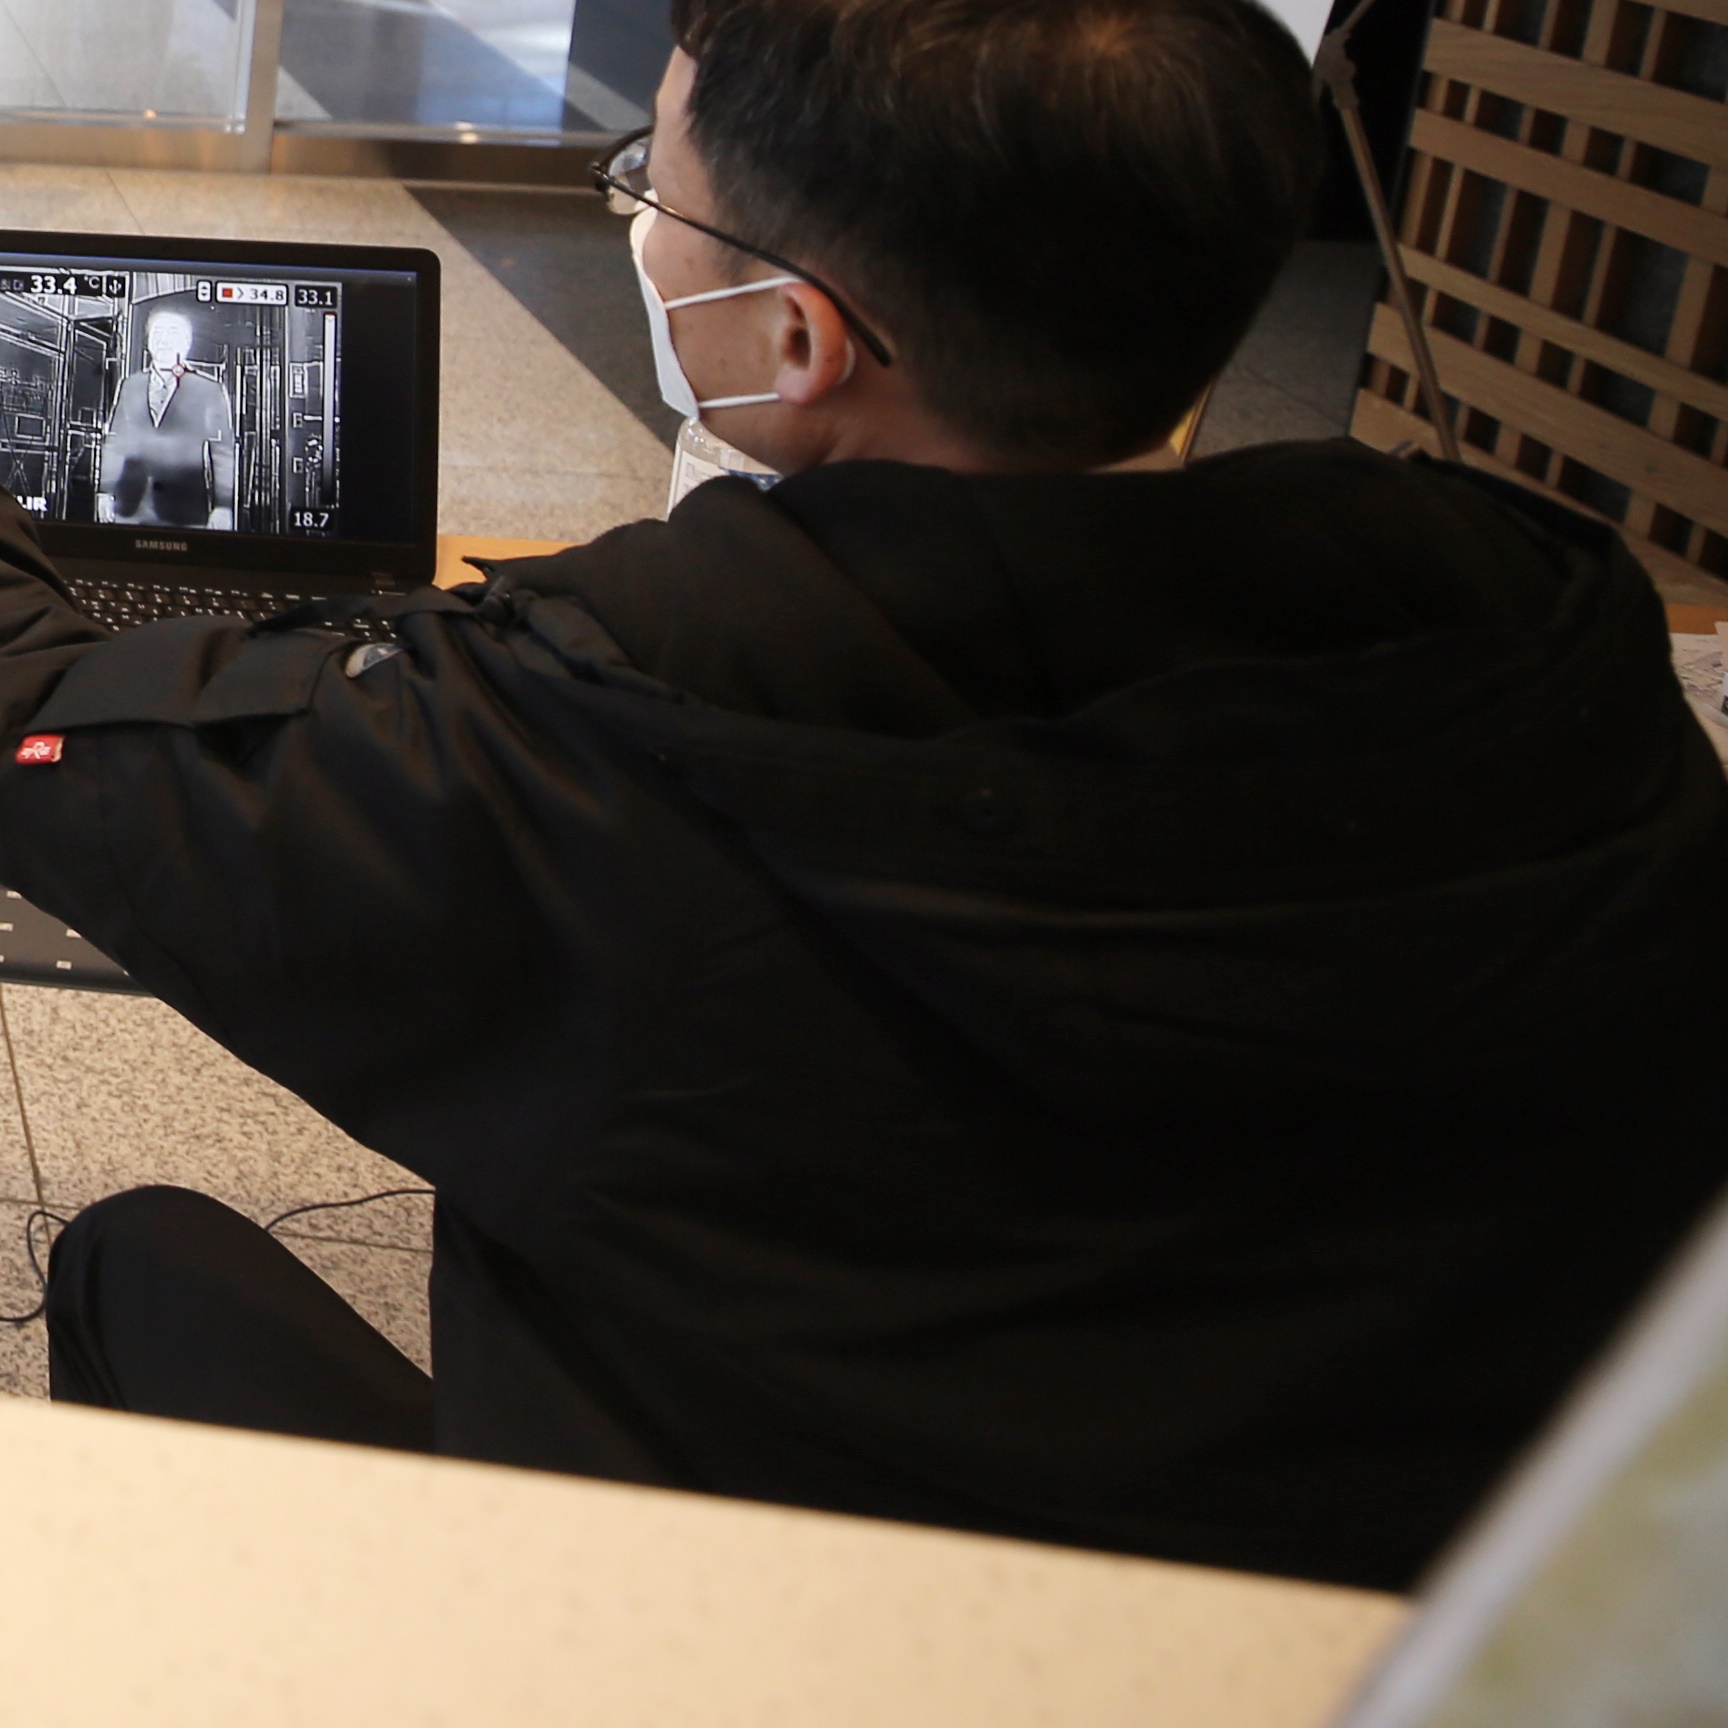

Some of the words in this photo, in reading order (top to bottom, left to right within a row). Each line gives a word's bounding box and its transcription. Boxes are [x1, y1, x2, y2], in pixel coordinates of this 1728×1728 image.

[30, 274, 78, 295] 33.4
[83, 275, 101, 289] °C
[249, 287, 285, 301] 34.8
[297, 288, 333, 306] 33.1
[17, 495, 48, 512] LIR
[294, 510, 330, 529] 18.7
[135, 538, 189, 552] SAMSUNG
